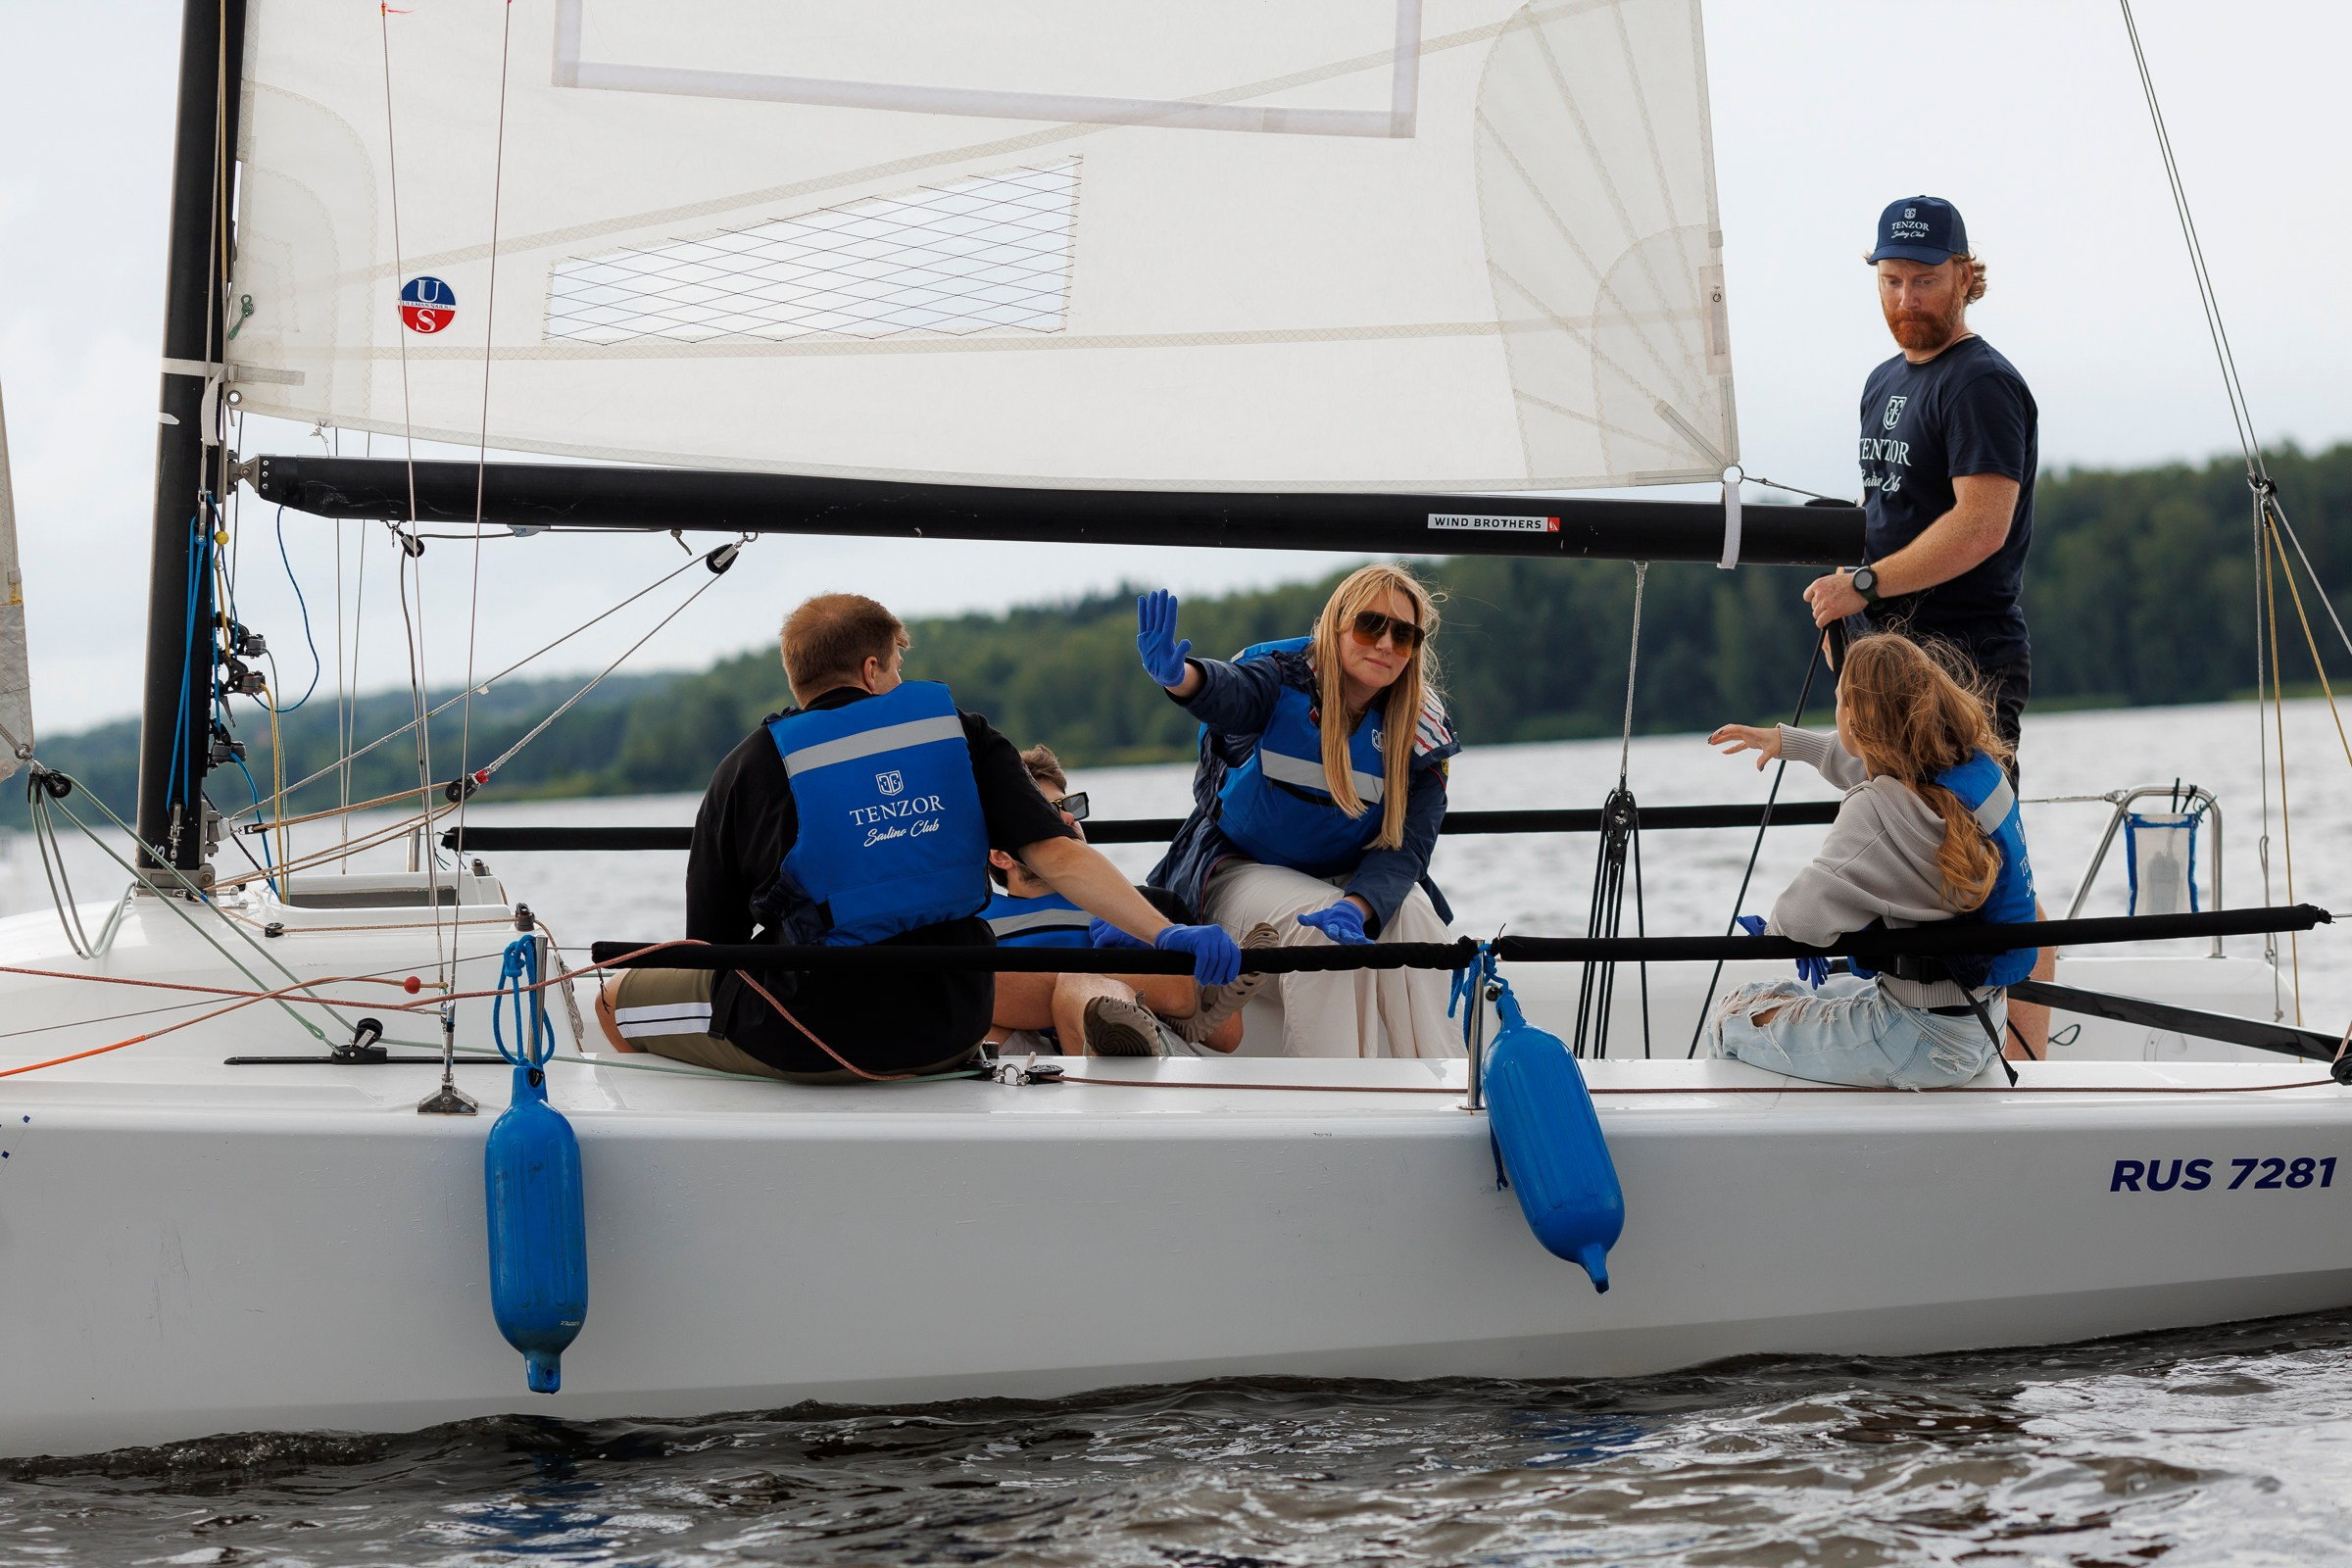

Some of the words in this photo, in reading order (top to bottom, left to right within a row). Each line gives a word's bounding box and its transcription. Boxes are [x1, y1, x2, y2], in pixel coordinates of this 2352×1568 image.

[1891, 220, 1930, 231] TENZOR
[416, 279, 442, 303] U
[416, 308, 437, 332] S
[1434, 516, 1469, 526] WIND
[1474, 518, 1542, 529] BROTHERS
[849, 795, 946, 826] TENZOR
[909, 818, 940, 837] Club
[2109, 1157, 2215, 1193] RUS
[2227, 1156, 2338, 1190] 7281
